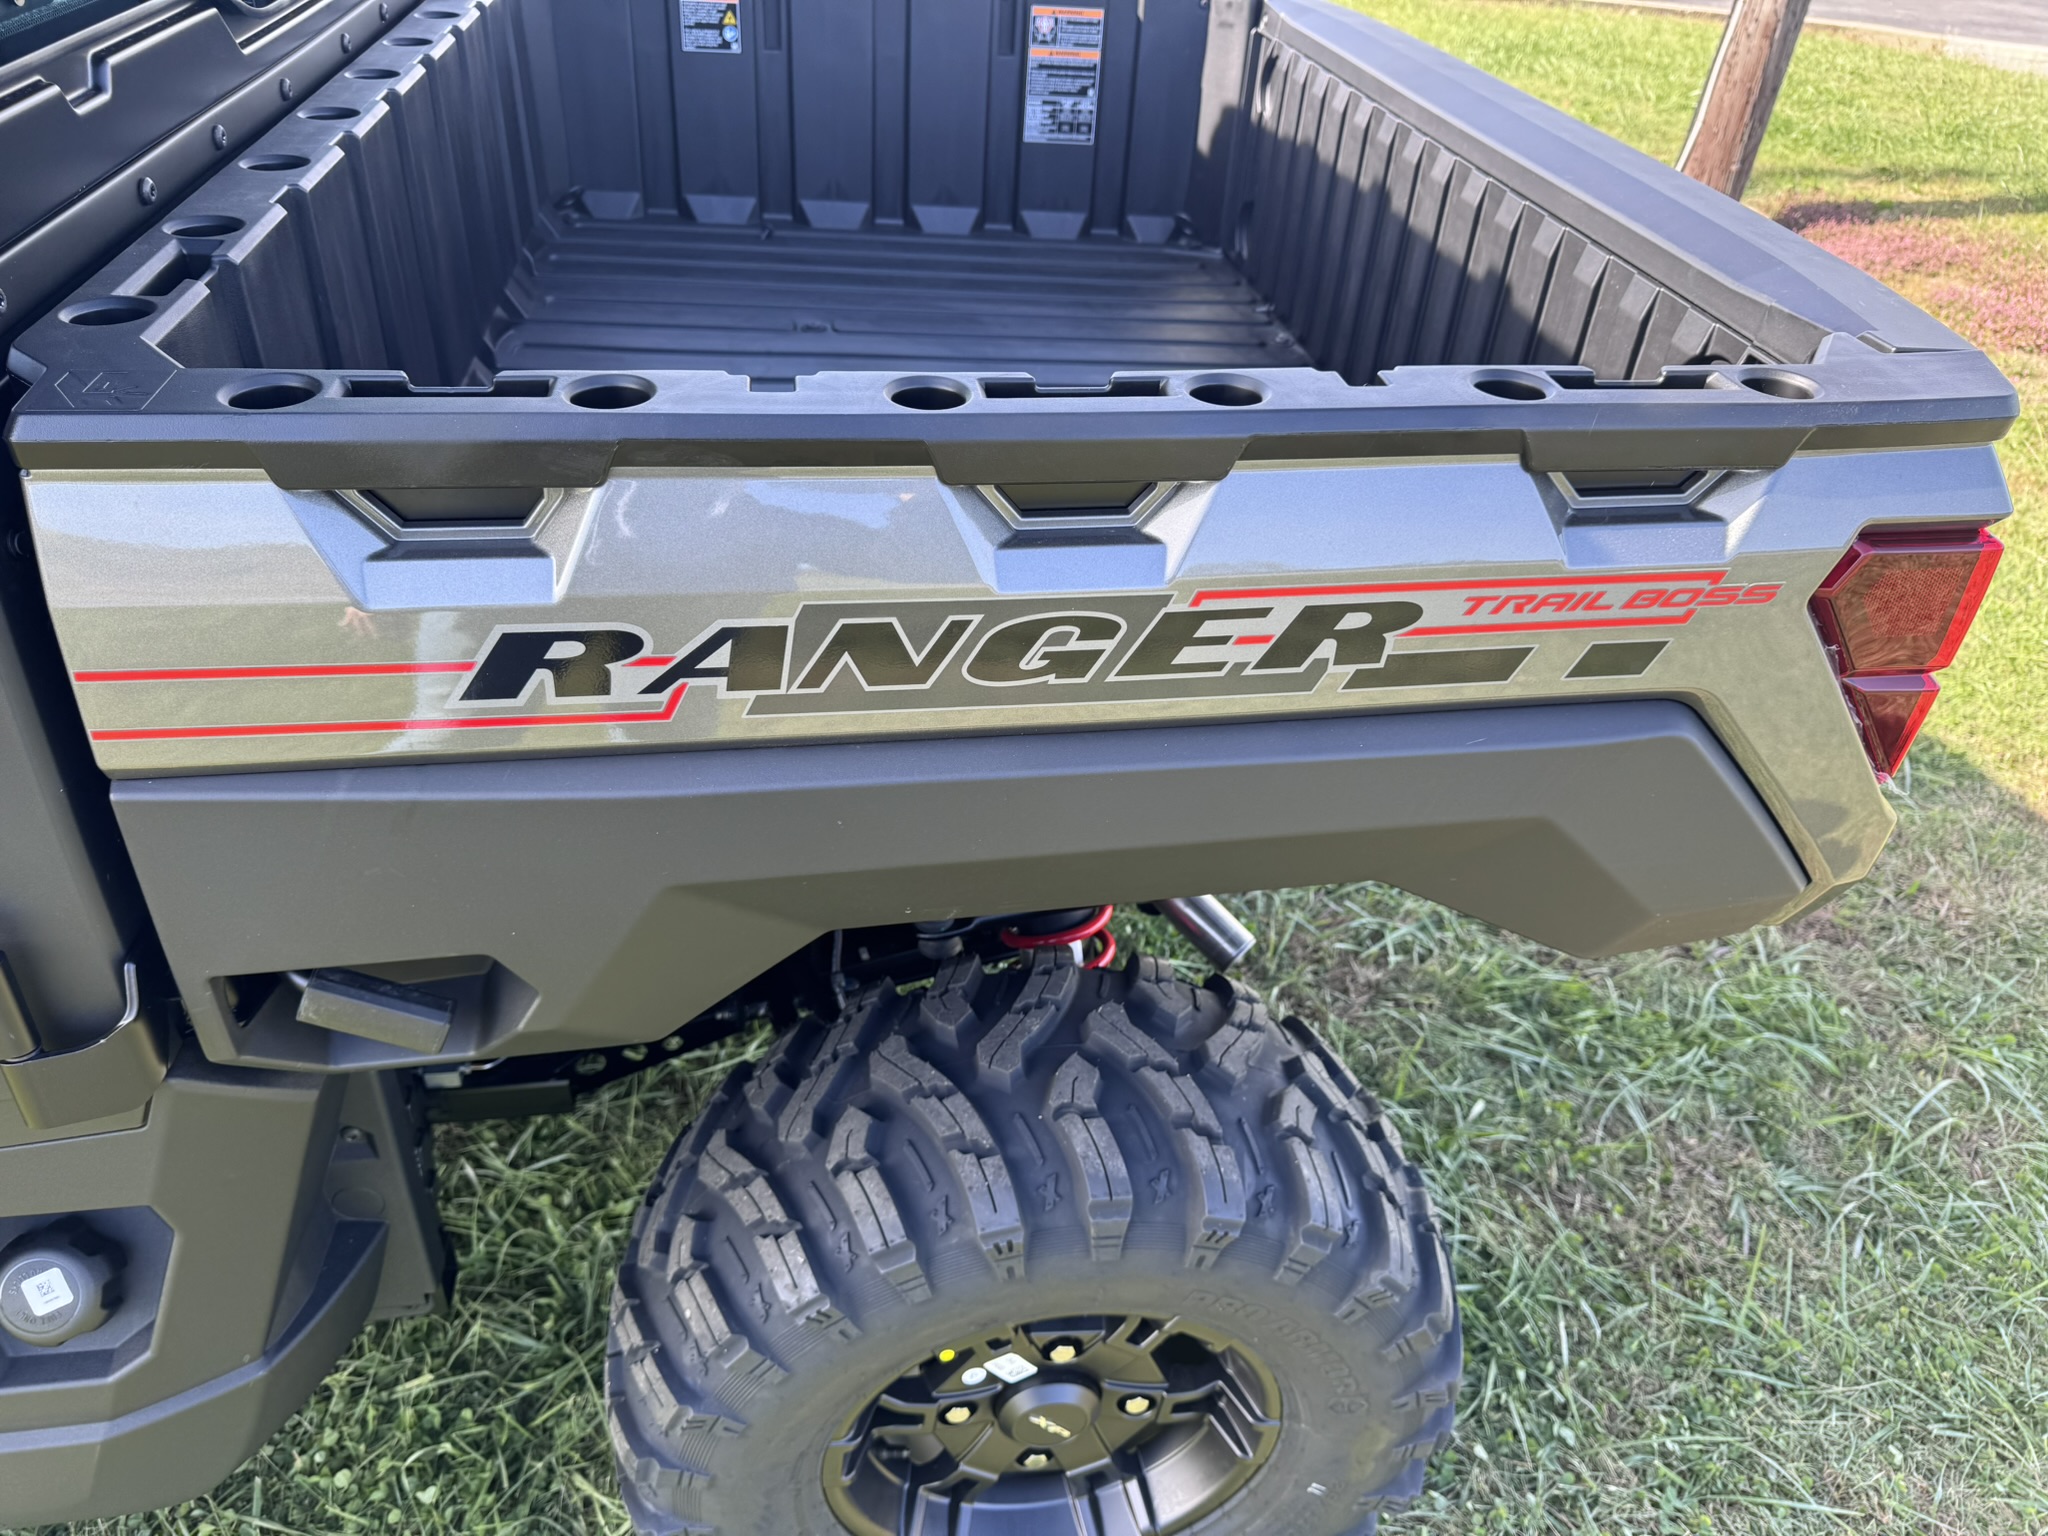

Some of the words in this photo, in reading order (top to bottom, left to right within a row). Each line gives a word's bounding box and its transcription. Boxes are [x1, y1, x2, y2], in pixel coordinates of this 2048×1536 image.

[1461, 590, 1614, 616] TRAIL
[1618, 583, 1786, 610] BOSS
[450, 598, 1424, 706] RANGER
